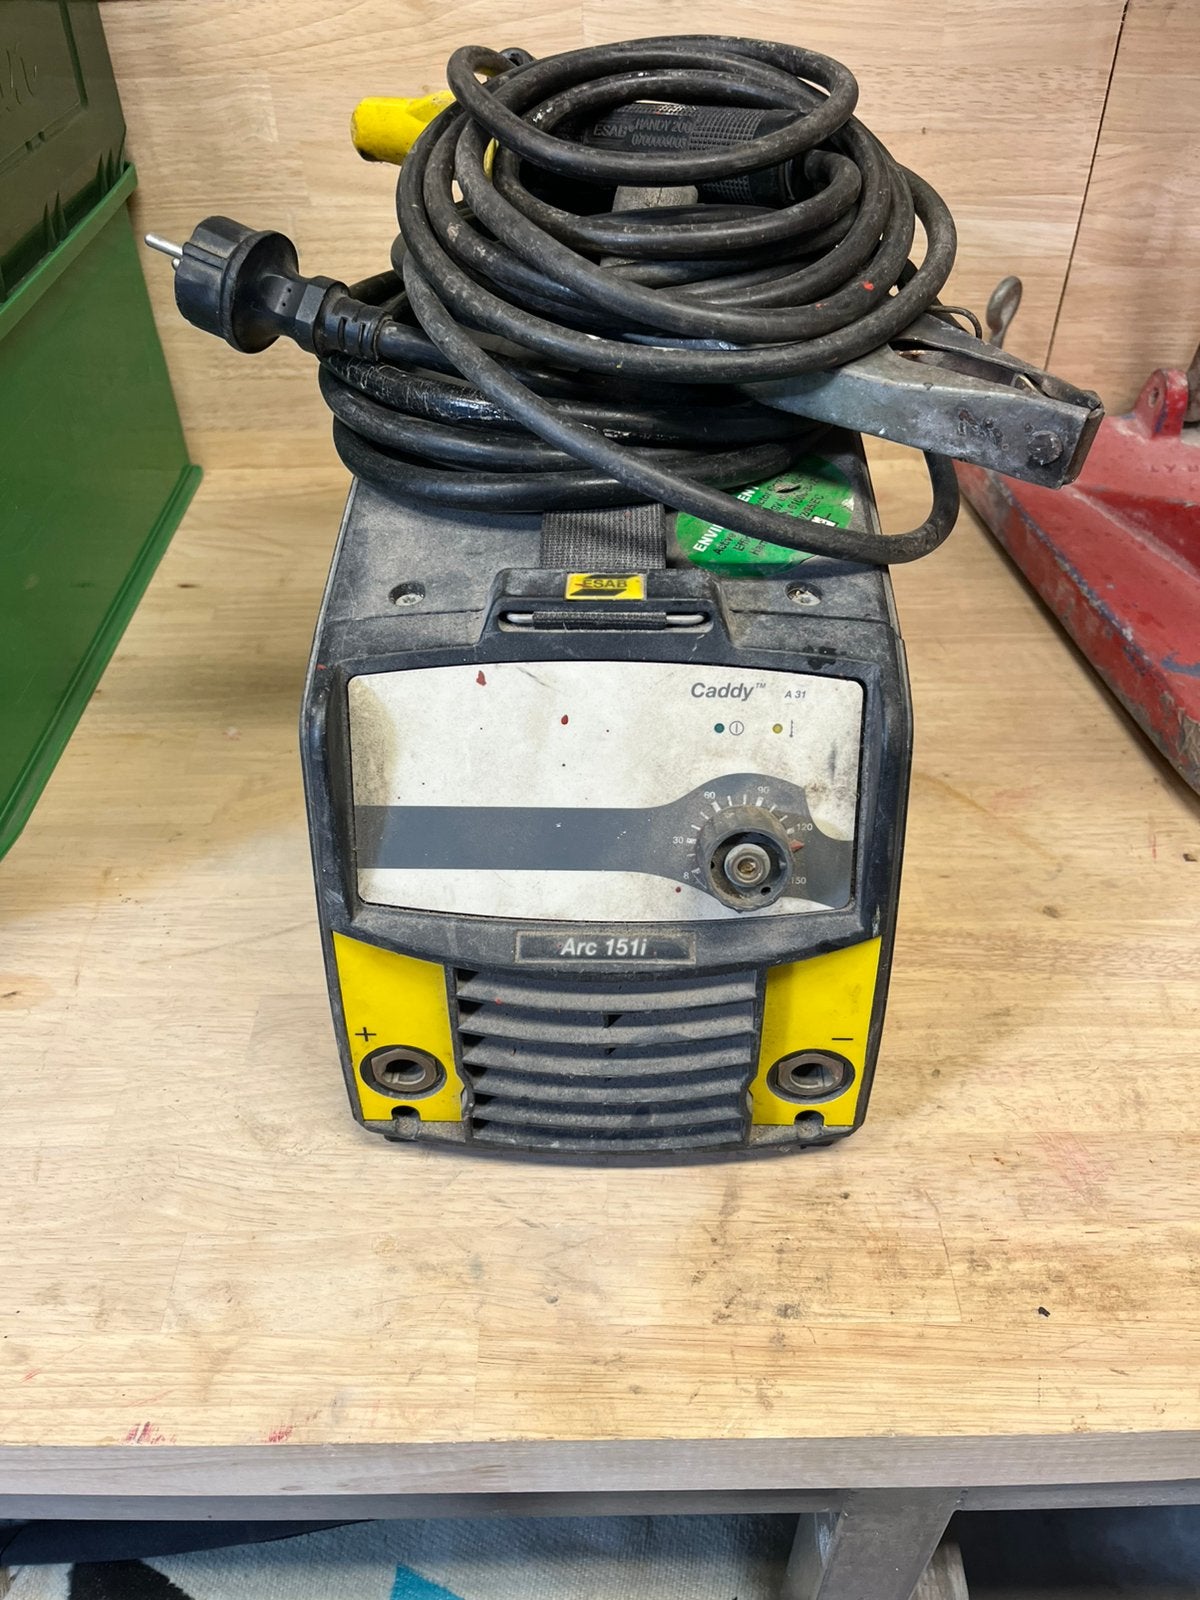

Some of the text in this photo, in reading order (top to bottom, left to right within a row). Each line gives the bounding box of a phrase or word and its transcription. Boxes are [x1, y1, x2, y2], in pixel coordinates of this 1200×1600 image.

[583, 579, 628, 589] ESAB
[784, 690, 793, 699] A
[794, 690, 807, 699] 31
[758, 786, 770, 794] 90
[703, 791, 716, 800] 60
[797, 822, 813, 832] 120
[672, 836, 684, 844] 30
[683, 872, 690, 880] 8
[791, 876, 807, 885] 150
[560, 937, 648, 957] Arc 151i
